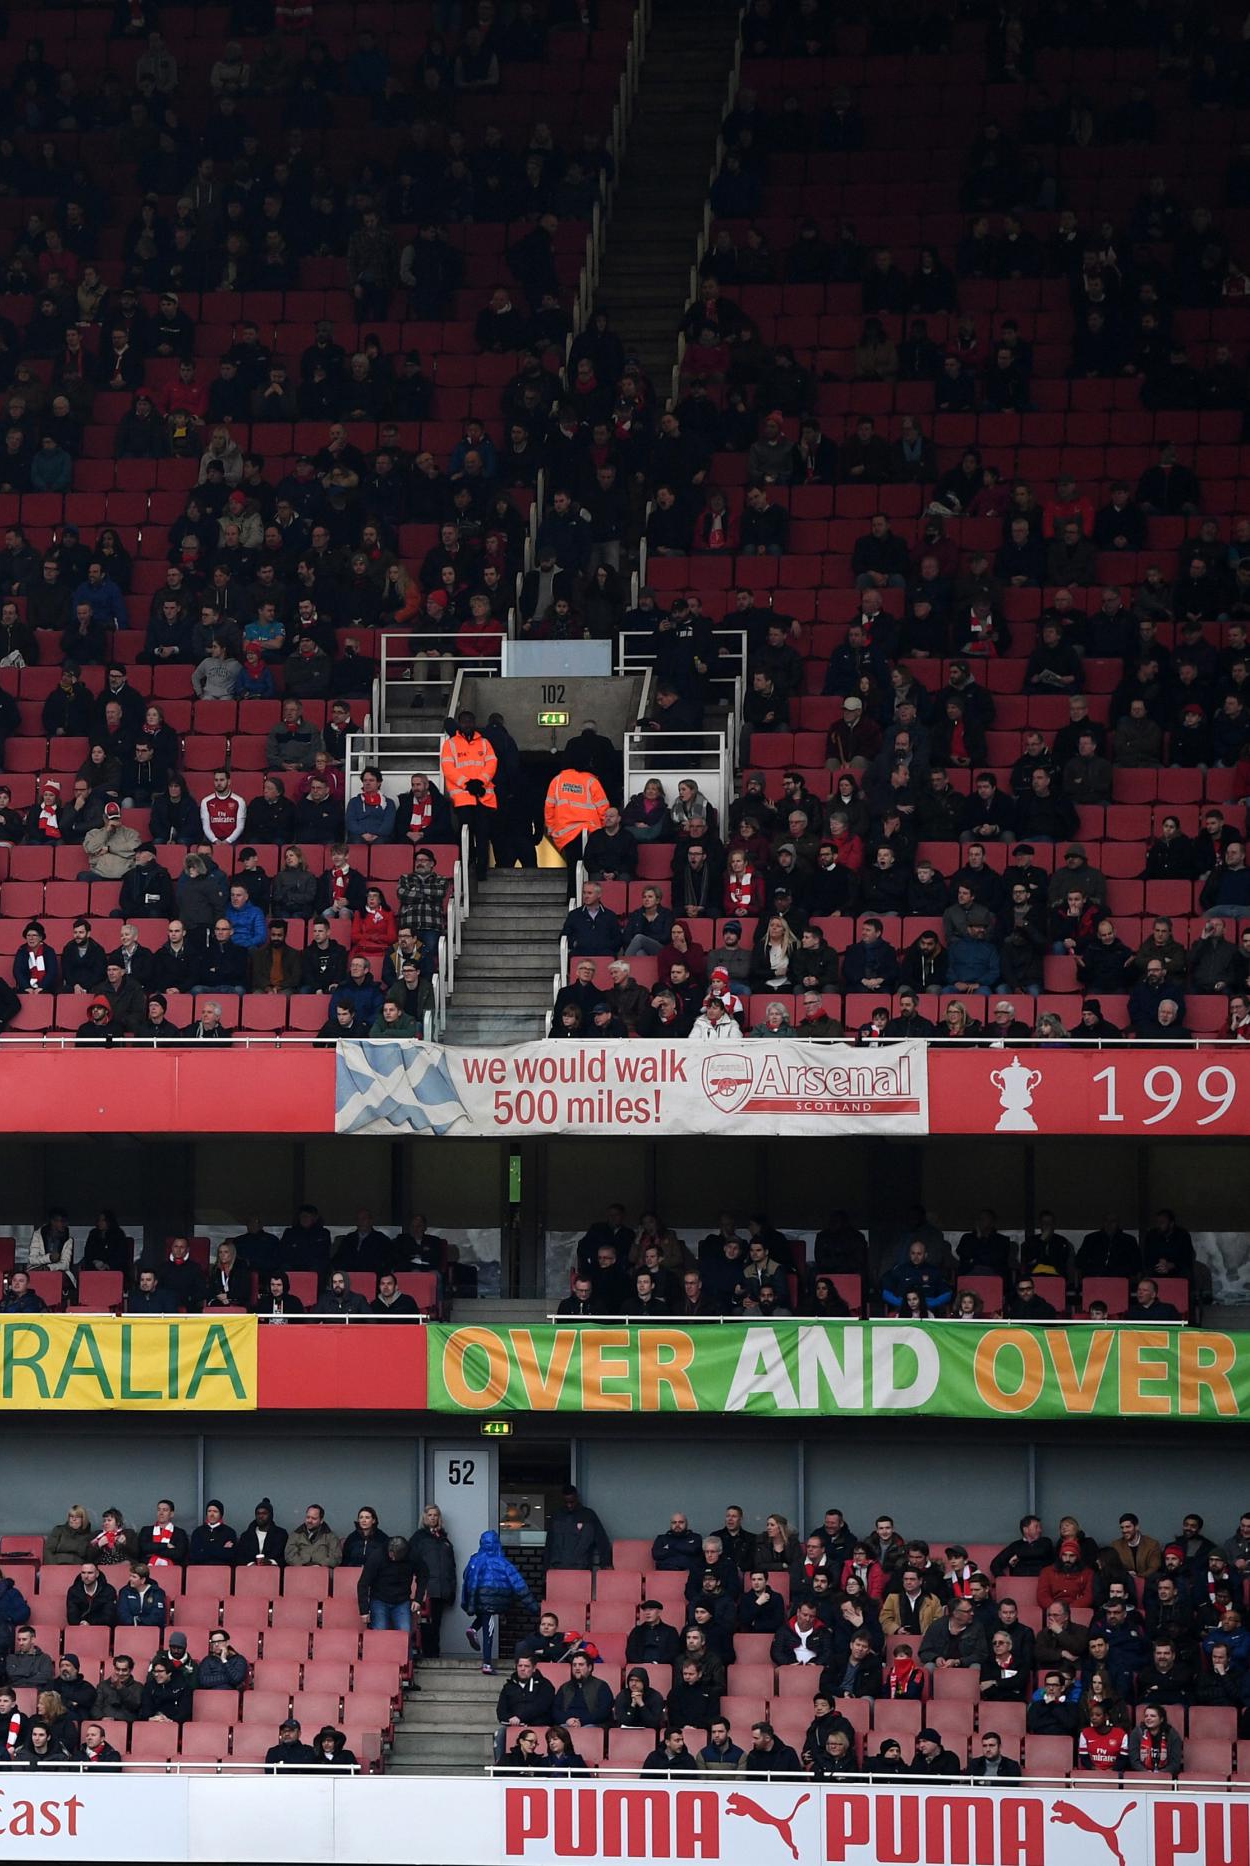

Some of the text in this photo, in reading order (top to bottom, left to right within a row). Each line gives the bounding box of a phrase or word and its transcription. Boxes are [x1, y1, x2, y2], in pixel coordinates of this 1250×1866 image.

[542, 684, 565, 704] 102
[463, 1049, 687, 1084] we would walk
[755, 1055, 910, 1096] Arsenal
[494, 1090, 661, 1124] 500 miles!
[797, 1102, 871, 1111] SCOTLAND
[1093, 1065, 1236, 1125] 199
[443, 1325, 1239, 1417] OVER AND OVER
[449, 1460, 474, 1485] 52
[505, 1788, 720, 1859] PUMA
[825, 1794, 1044, 1866] PUMA
[1154, 1802, 1250, 1866] PU
